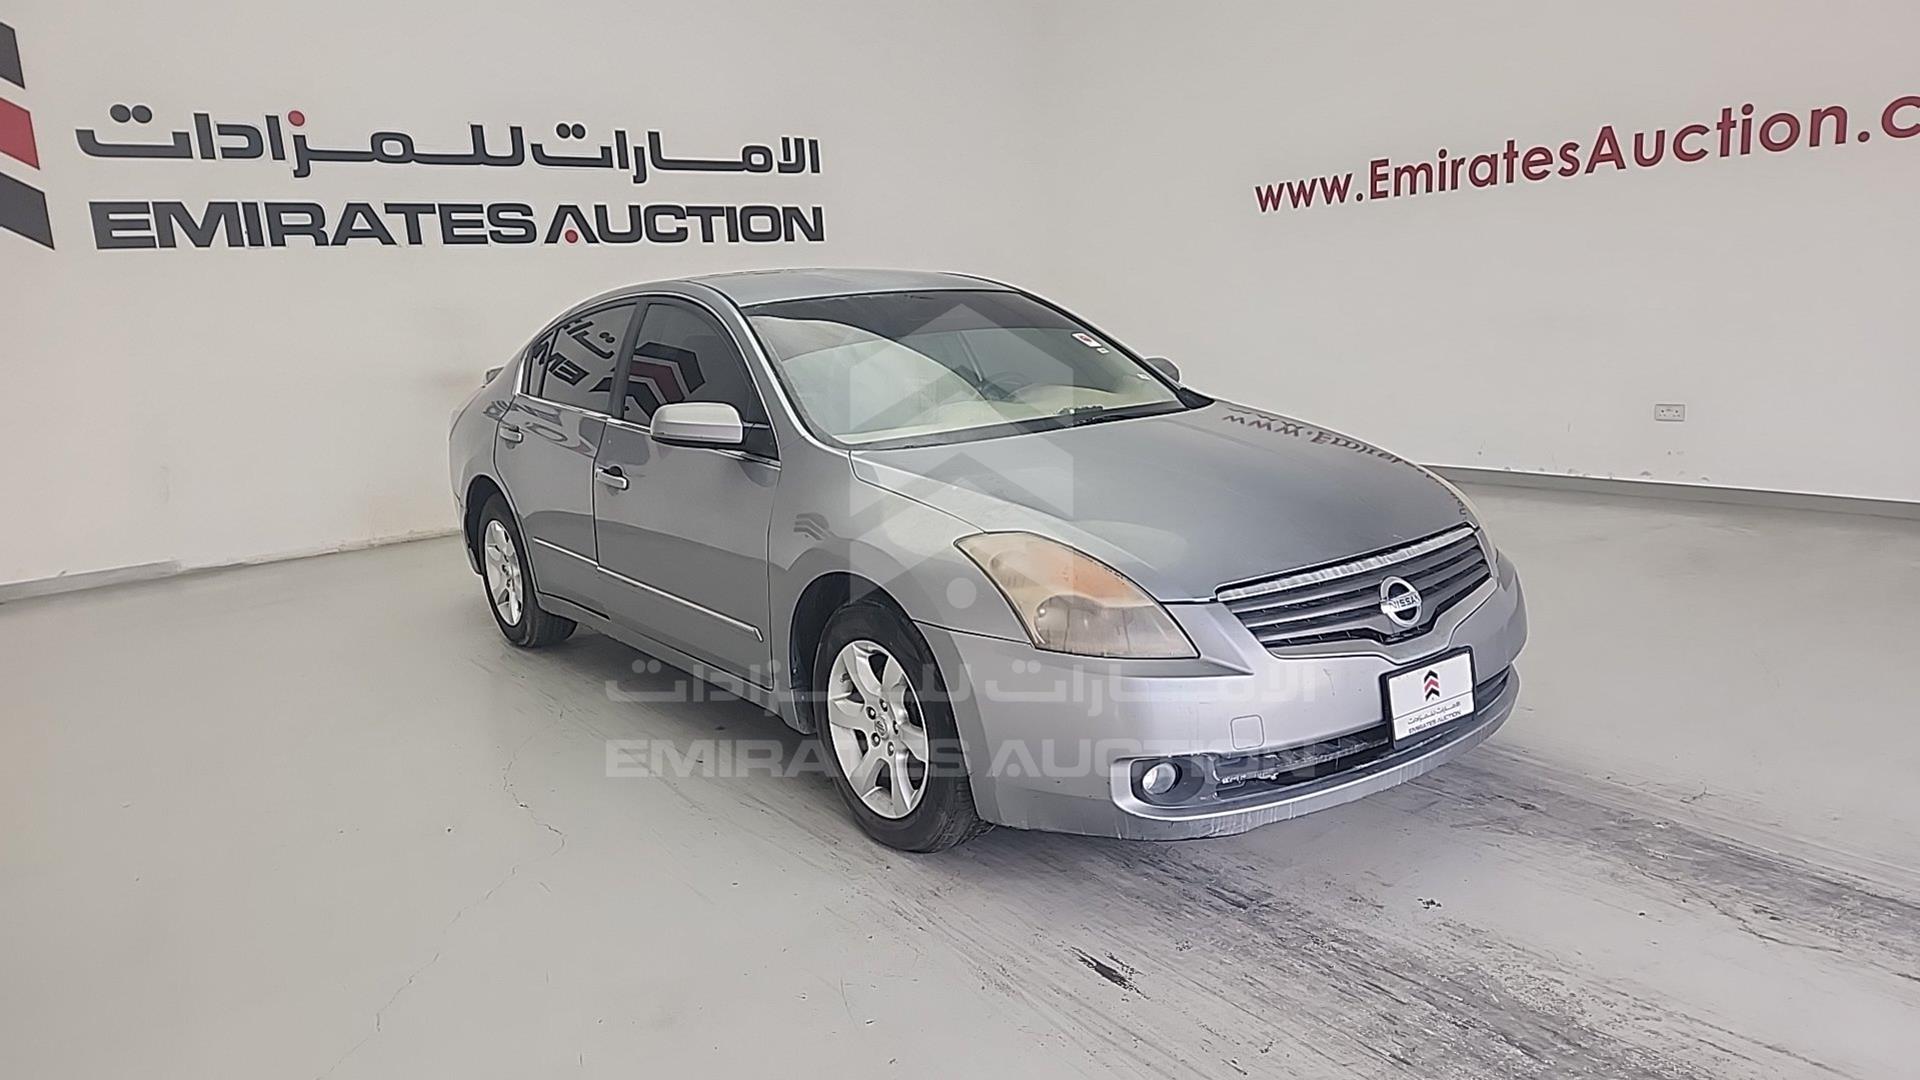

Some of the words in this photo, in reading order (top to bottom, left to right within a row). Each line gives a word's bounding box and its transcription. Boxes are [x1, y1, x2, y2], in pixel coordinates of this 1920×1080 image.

[88, 201, 537, 249] EMIRATES
[543, 204, 825, 244] AUCTION
[1388, 594, 1421, 609] NISSAN
